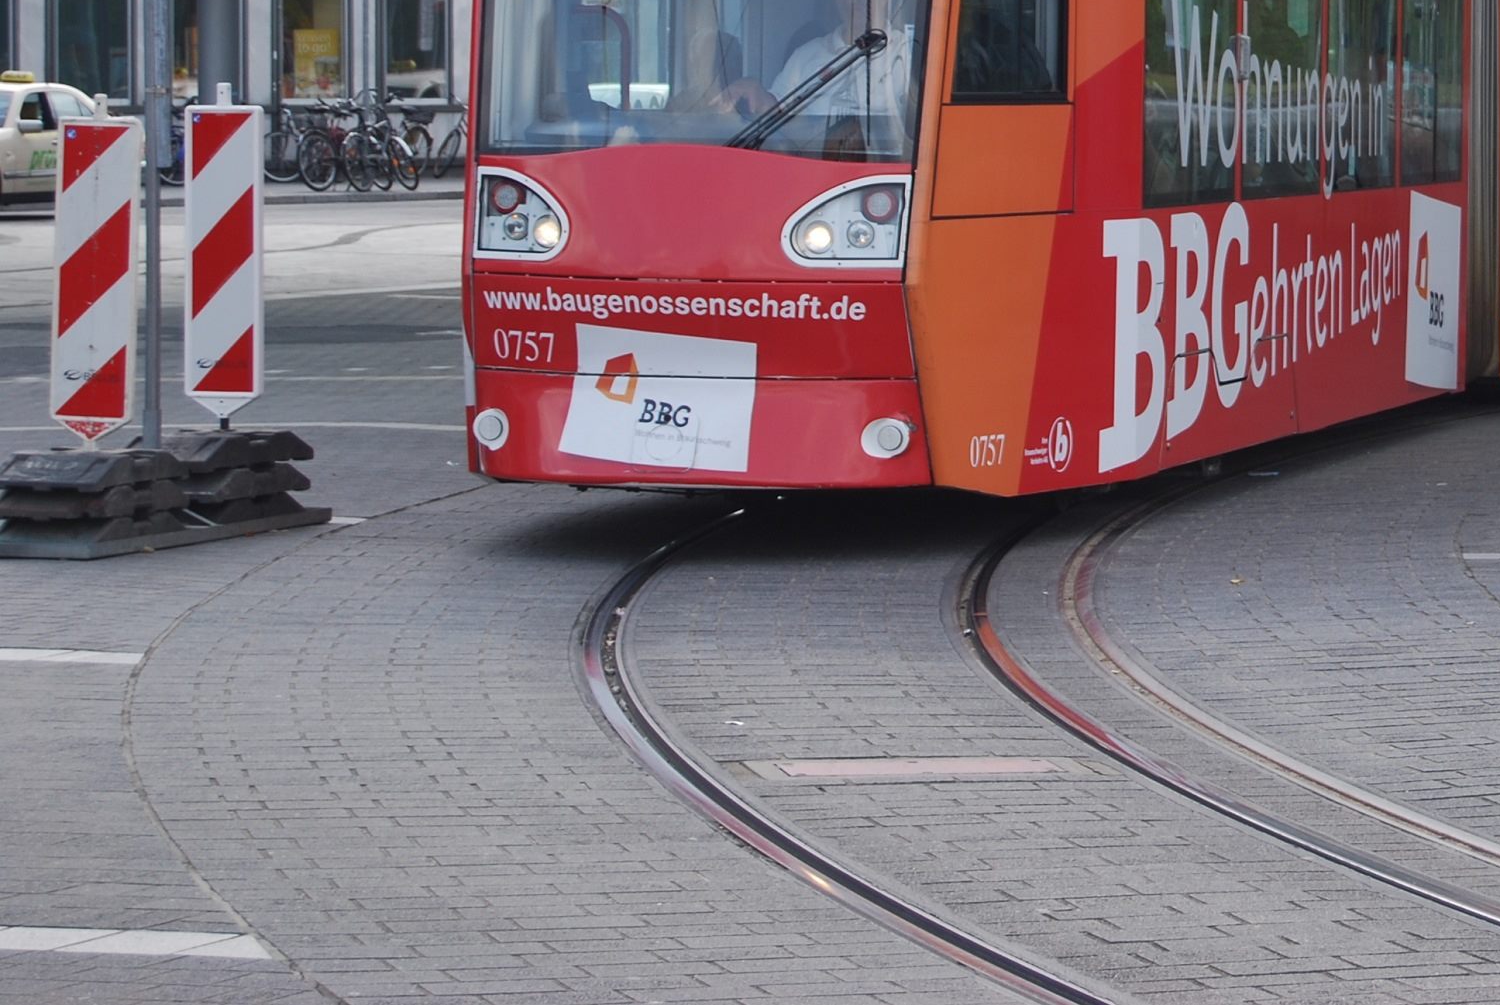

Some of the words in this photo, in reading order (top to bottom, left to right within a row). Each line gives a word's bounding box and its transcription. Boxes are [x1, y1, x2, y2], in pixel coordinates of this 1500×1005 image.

[1368, 55, 1384, 157] in
[483, 286, 867, 322] www.baugenossenschaft.de
[1429, 290, 1445, 328] BBG
[493, 328, 556, 364] 0757
[1098, 201, 1343, 474] BBGehrten
[1351, 222, 1401, 346] Lagen
[638, 398, 691, 428] BBG
[969, 433, 1006, 468] 0757
